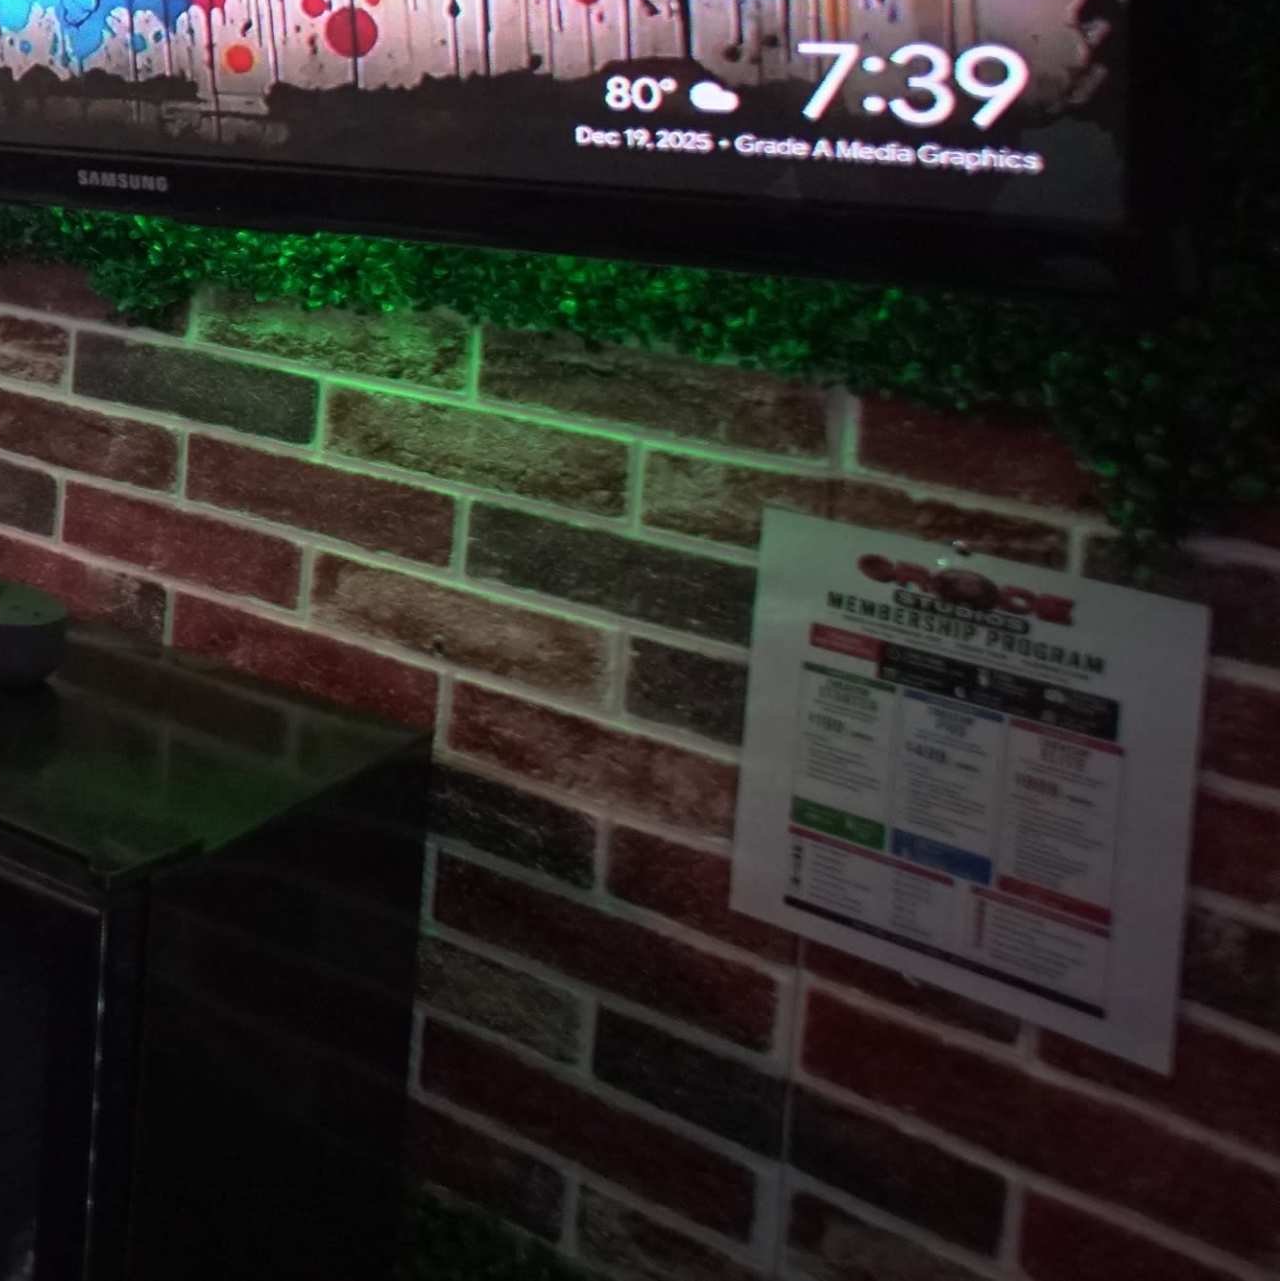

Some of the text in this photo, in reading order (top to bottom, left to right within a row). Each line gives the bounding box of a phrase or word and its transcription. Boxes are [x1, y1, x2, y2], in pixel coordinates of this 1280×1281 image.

[606, 42, 1029, 130] 80° 7:39
[77, 169, 168, 192] SAMSUNG
[575, 125, 621, 146] Dec
[656, 130, 712, 152] 2025
[735, 135, 810, 158] Grade
[811, 140, 832, 159] A
[835, 140, 915, 164] Media
[917, 144, 1043, 174] Graphics
[827, 591, 1107, 673] MEMBERSHIP PROGRAM
